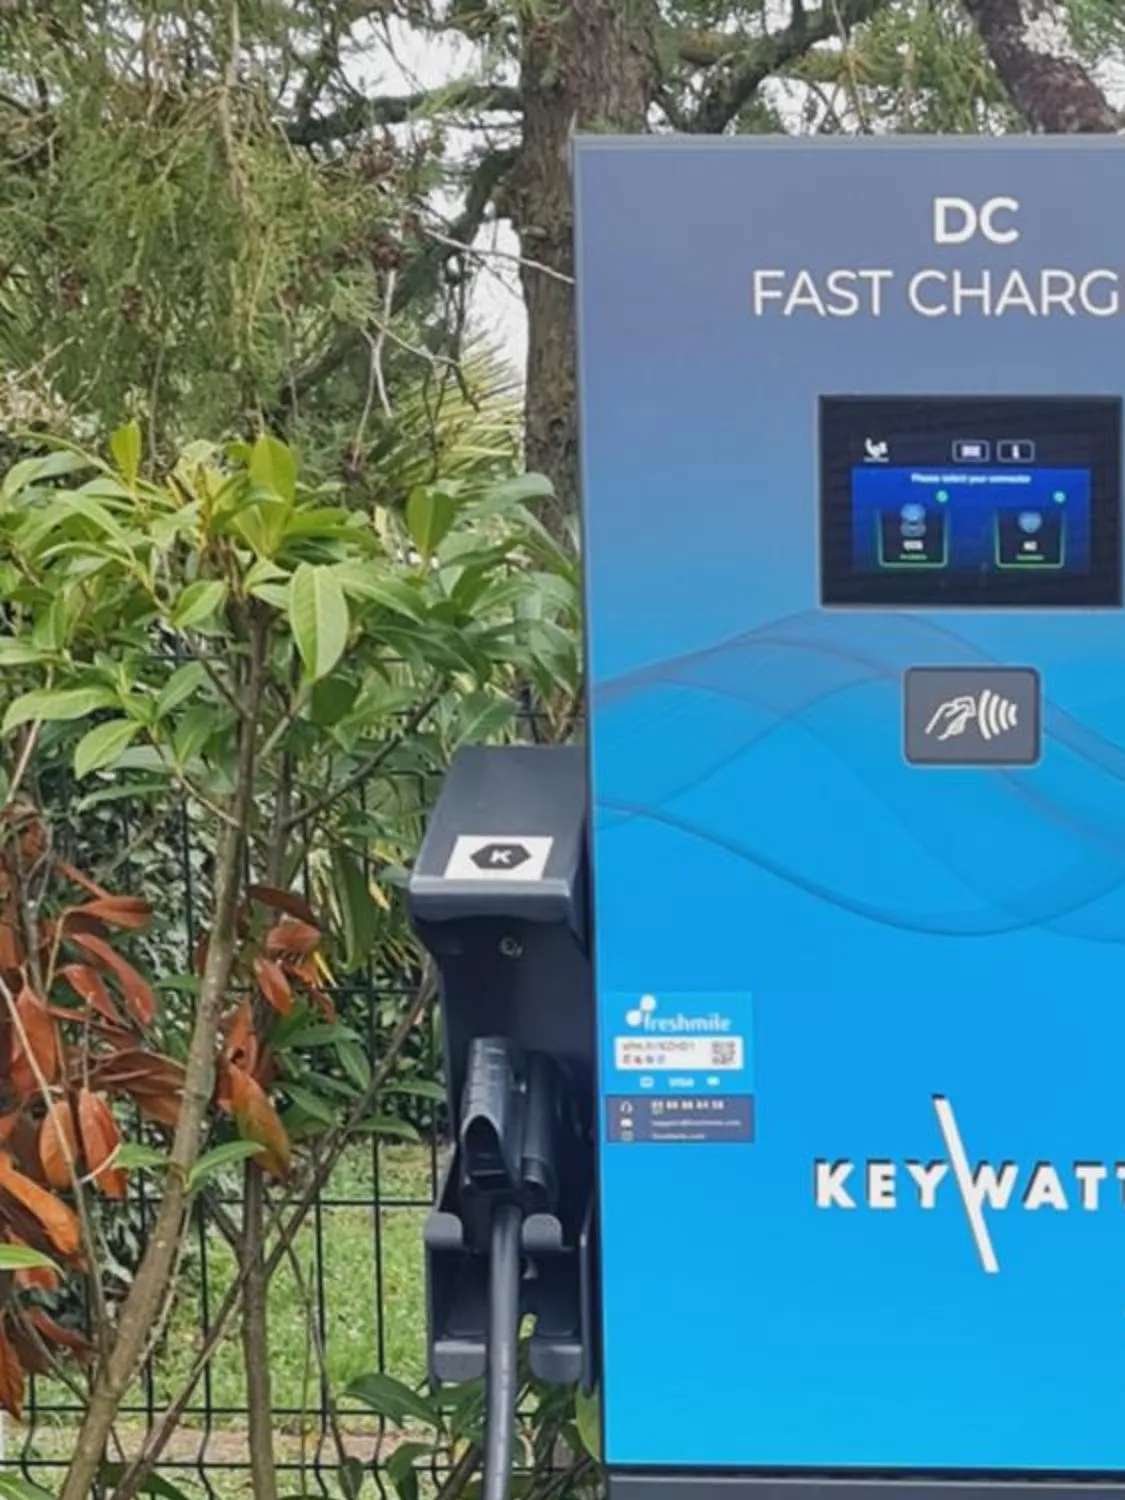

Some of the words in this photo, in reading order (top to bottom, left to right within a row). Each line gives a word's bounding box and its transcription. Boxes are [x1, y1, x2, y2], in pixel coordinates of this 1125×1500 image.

[933, 196, 1020, 244] DC
[752, 269, 893, 317] FAST
[488, 849, 514, 865] K
[643, 1012, 732, 1032] freshmile
